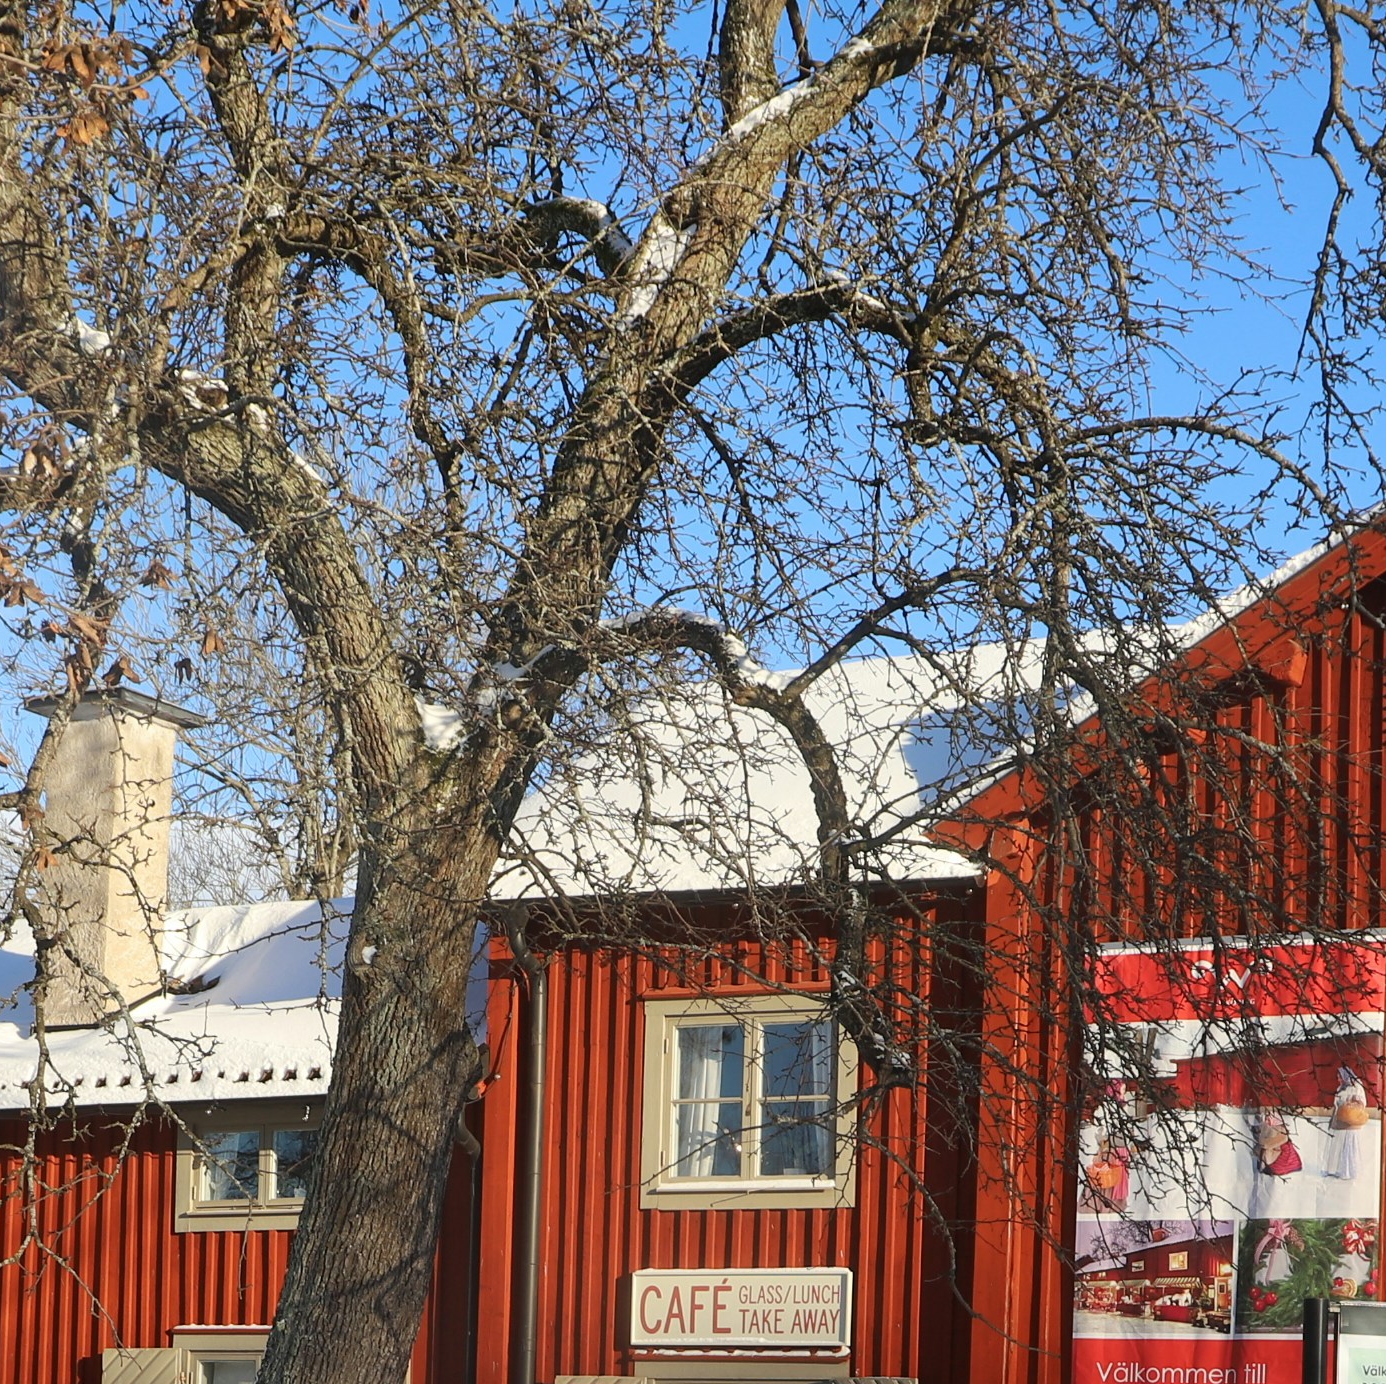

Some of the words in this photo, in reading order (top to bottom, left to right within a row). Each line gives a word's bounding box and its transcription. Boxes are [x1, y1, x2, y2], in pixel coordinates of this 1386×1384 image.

[639, 1278, 732, 1334] CAFÉ
[738, 1285, 840, 1304] GLASS/LUNCH
[739, 1309, 785, 1334] TAKE
[790, 1309, 840, 1334] AWAY
[1096, 1361, 1237, 1384] Välkommen
[1244, 1363, 1266, 1384] till
